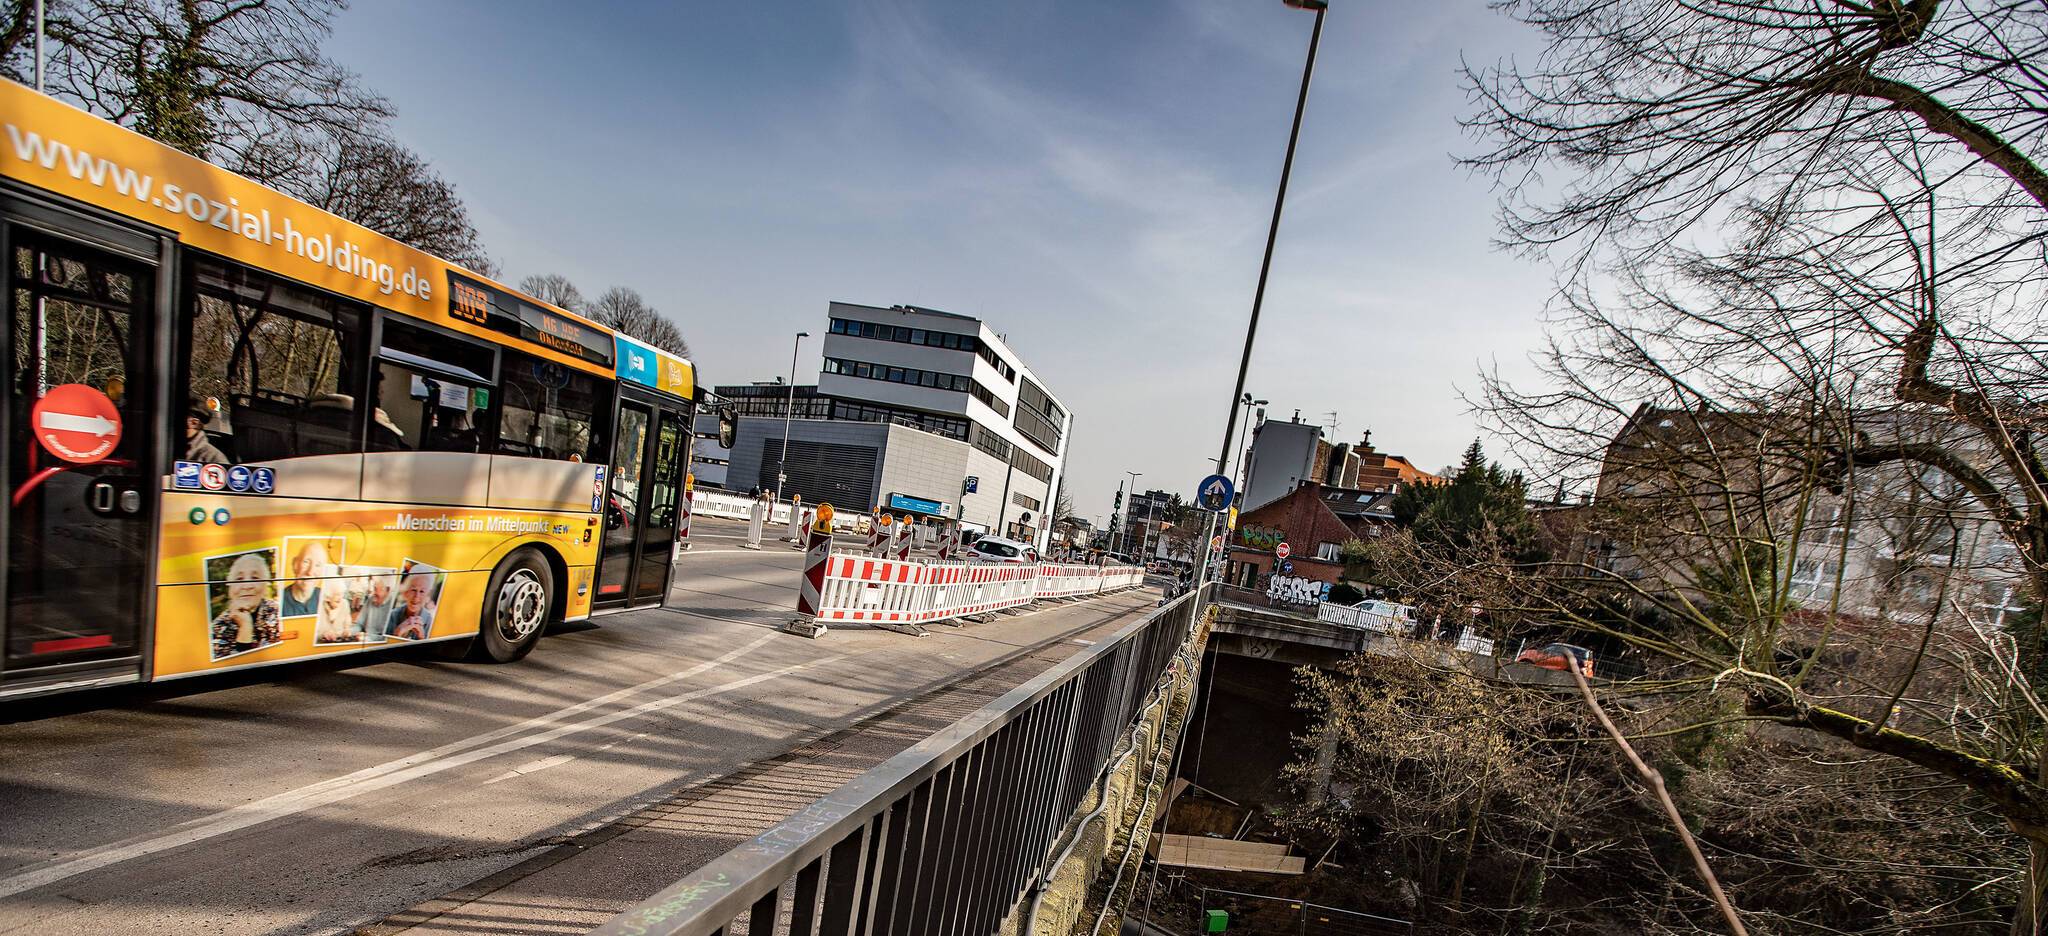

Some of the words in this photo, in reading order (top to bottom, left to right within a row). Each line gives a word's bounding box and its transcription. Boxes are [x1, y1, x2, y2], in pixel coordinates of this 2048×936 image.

[5, 123, 432, 302] www.sozial-holding.de
[468, 516, 483, 531] im
[486, 516, 549, 536] Mittelpunkt
[552, 524, 569, 534] NEW
[1277, 546, 1289, 555] STOP
